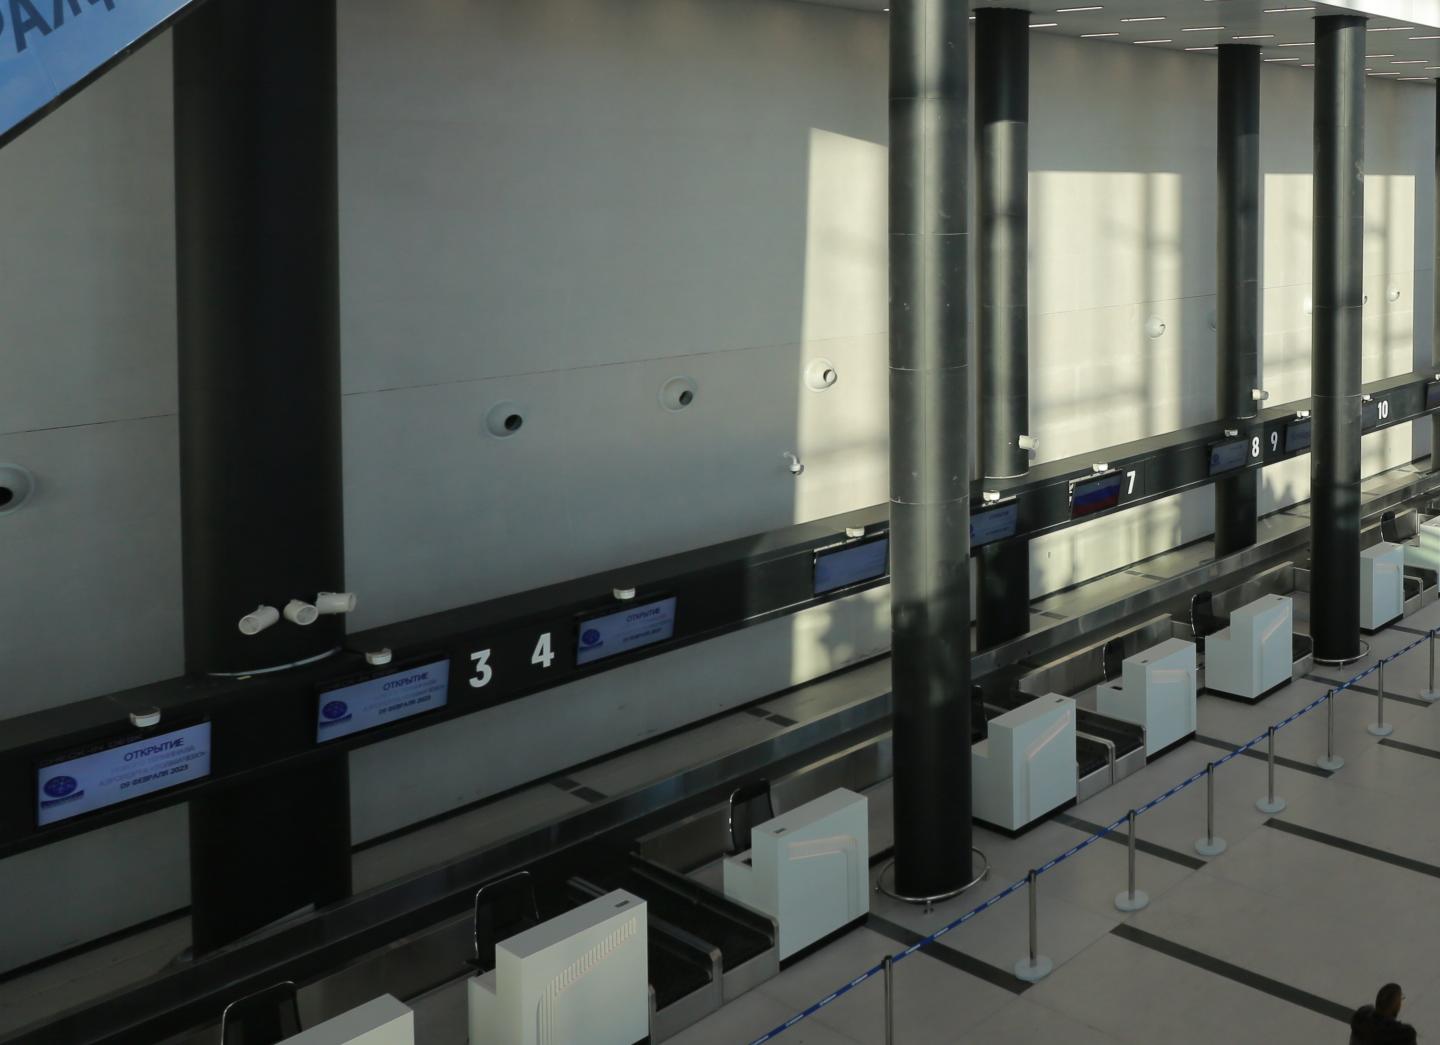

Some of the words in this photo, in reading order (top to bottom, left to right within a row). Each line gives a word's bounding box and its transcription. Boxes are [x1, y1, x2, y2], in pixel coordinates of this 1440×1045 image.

[1377, 400, 1388, 420] 10
[1251, 436, 1260, 458] 8
[1270, 431, 1278, 452] 9
[1126, 471, 1136, 495] 7
[468, 648, 493, 688] 3
[531, 632, 555, 668] 4
[123, 737, 184, 762] ОТКРЫТИЕ
